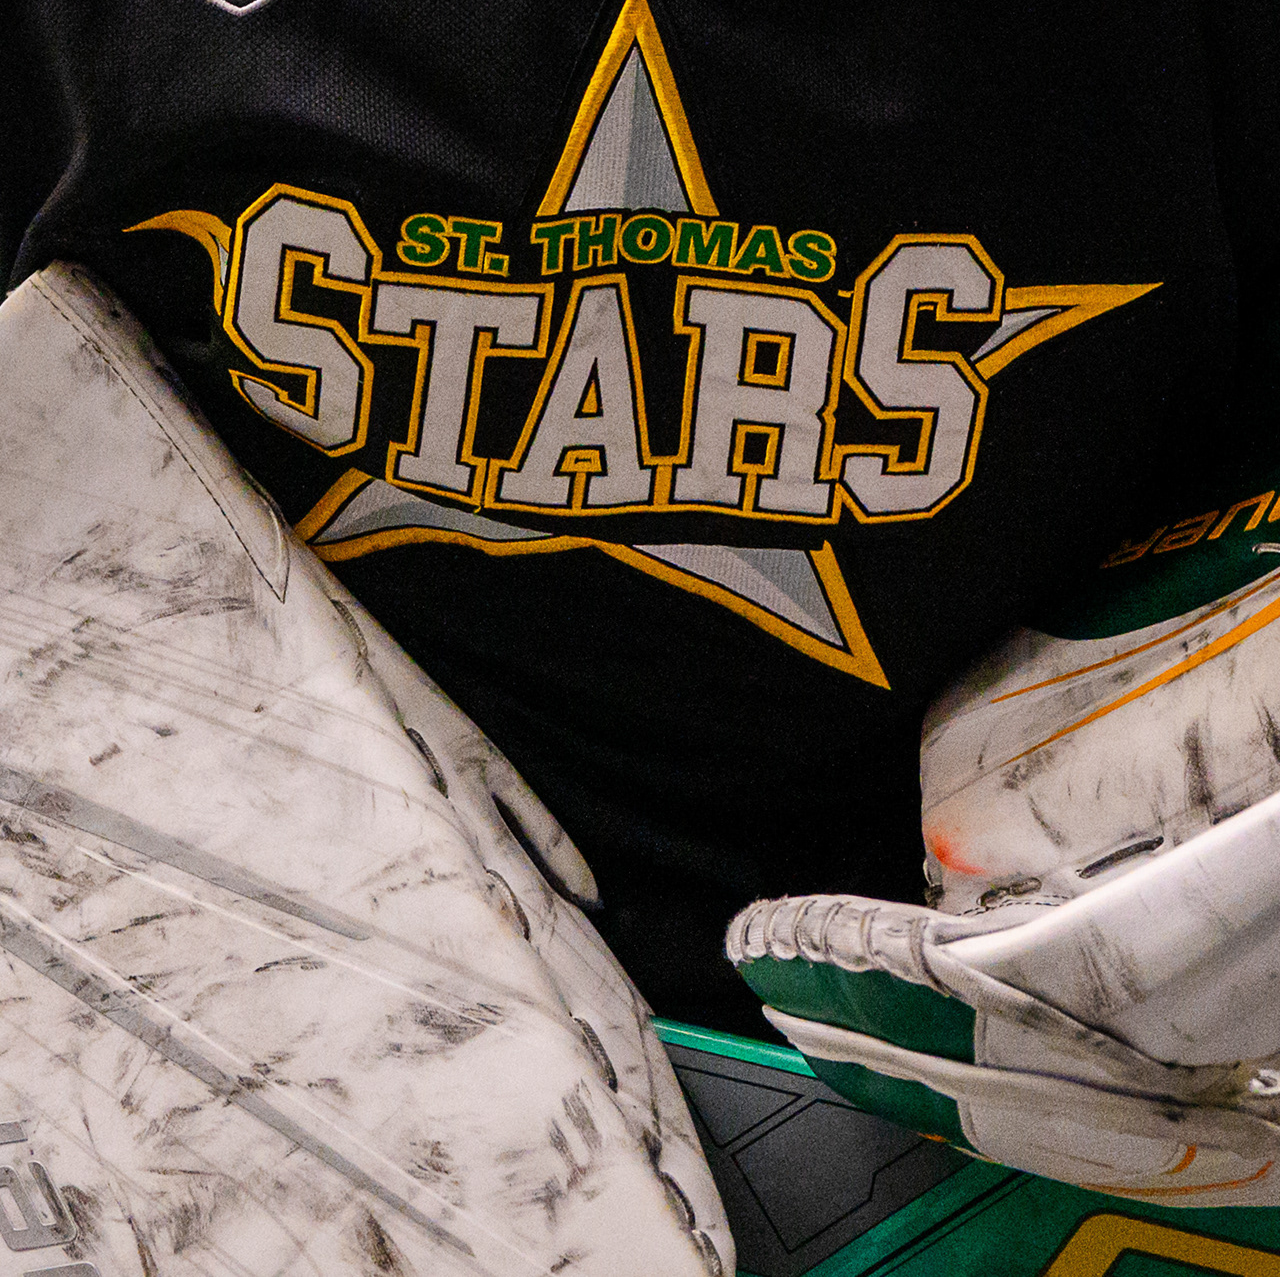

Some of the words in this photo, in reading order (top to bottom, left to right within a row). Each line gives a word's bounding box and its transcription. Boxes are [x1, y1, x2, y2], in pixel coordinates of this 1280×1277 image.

[395, 212, 510, 278] ST.
[529, 213, 838, 283] THOMAS
[223, 182, 1006, 525] STARS
